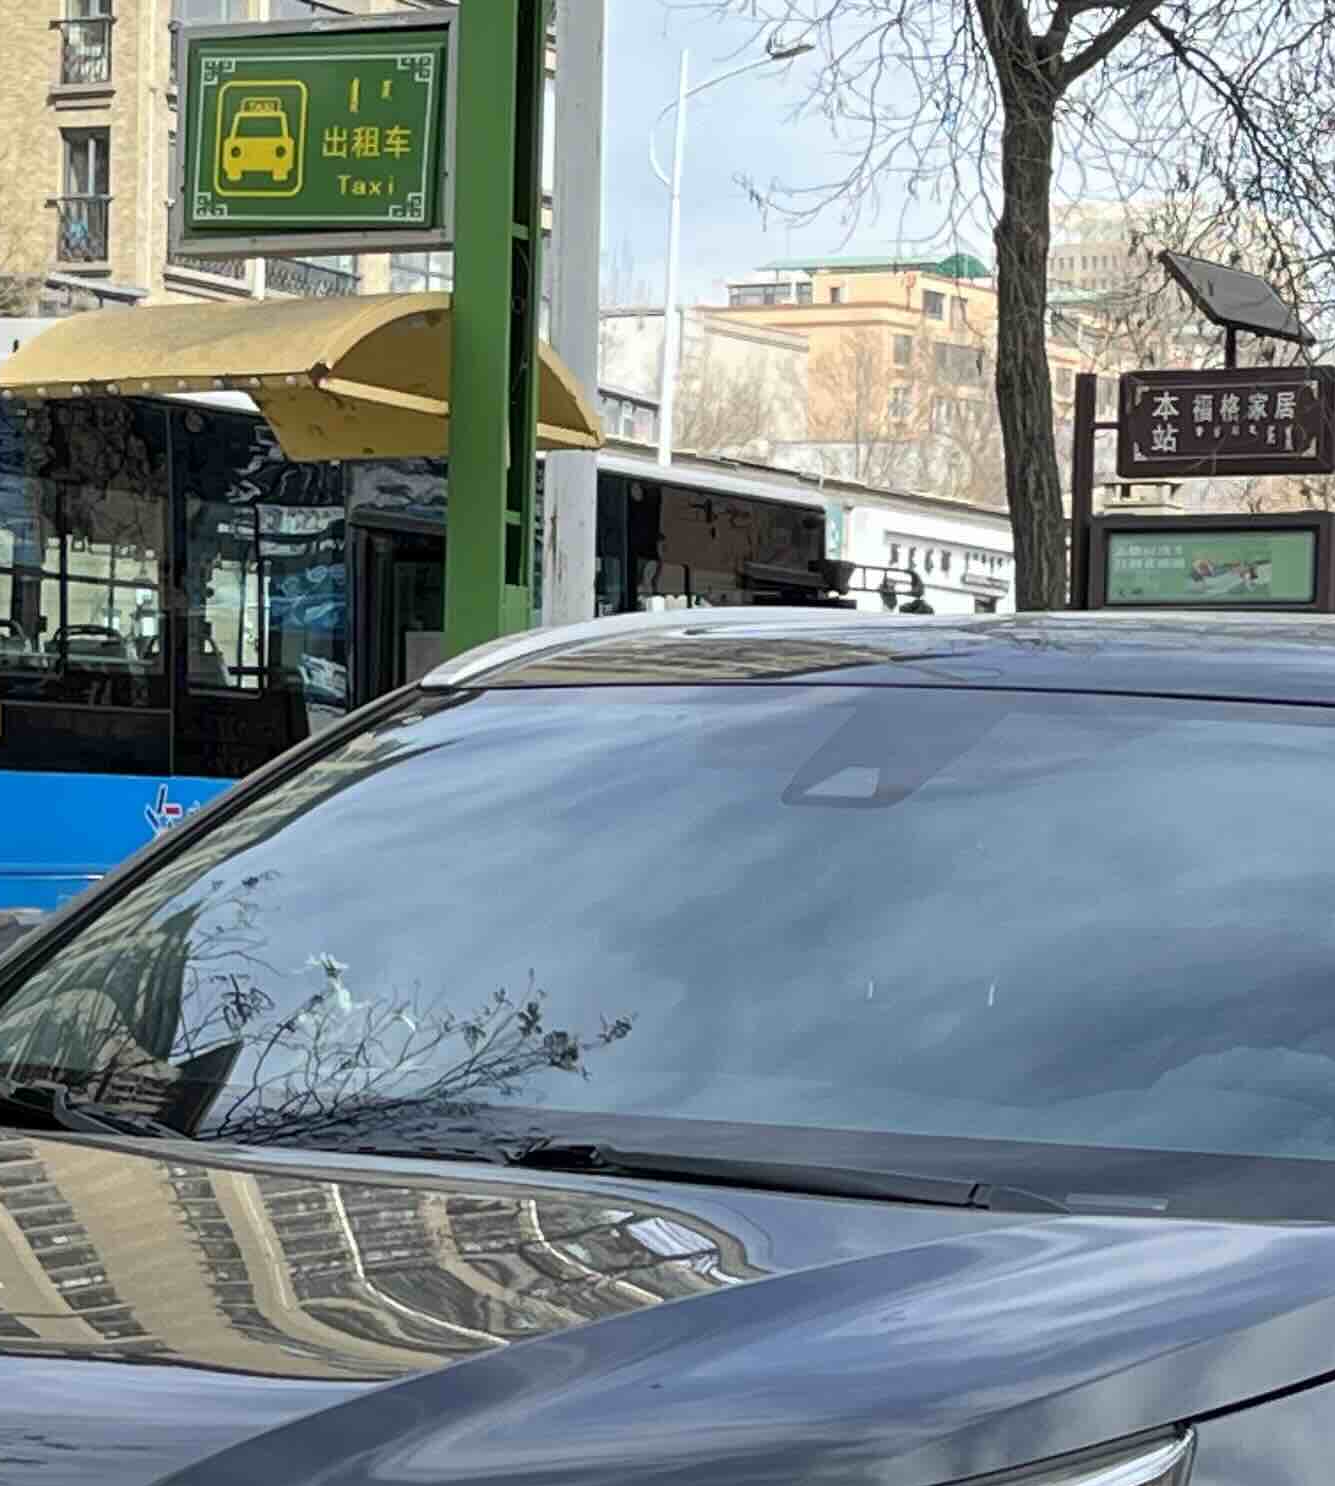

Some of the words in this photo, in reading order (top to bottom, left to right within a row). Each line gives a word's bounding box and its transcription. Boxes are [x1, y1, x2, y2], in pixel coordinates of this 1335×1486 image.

[322, 125, 412, 159] 出租车
[337, 175, 395, 196] Taxi
[1151, 391, 1180, 453] 本站
